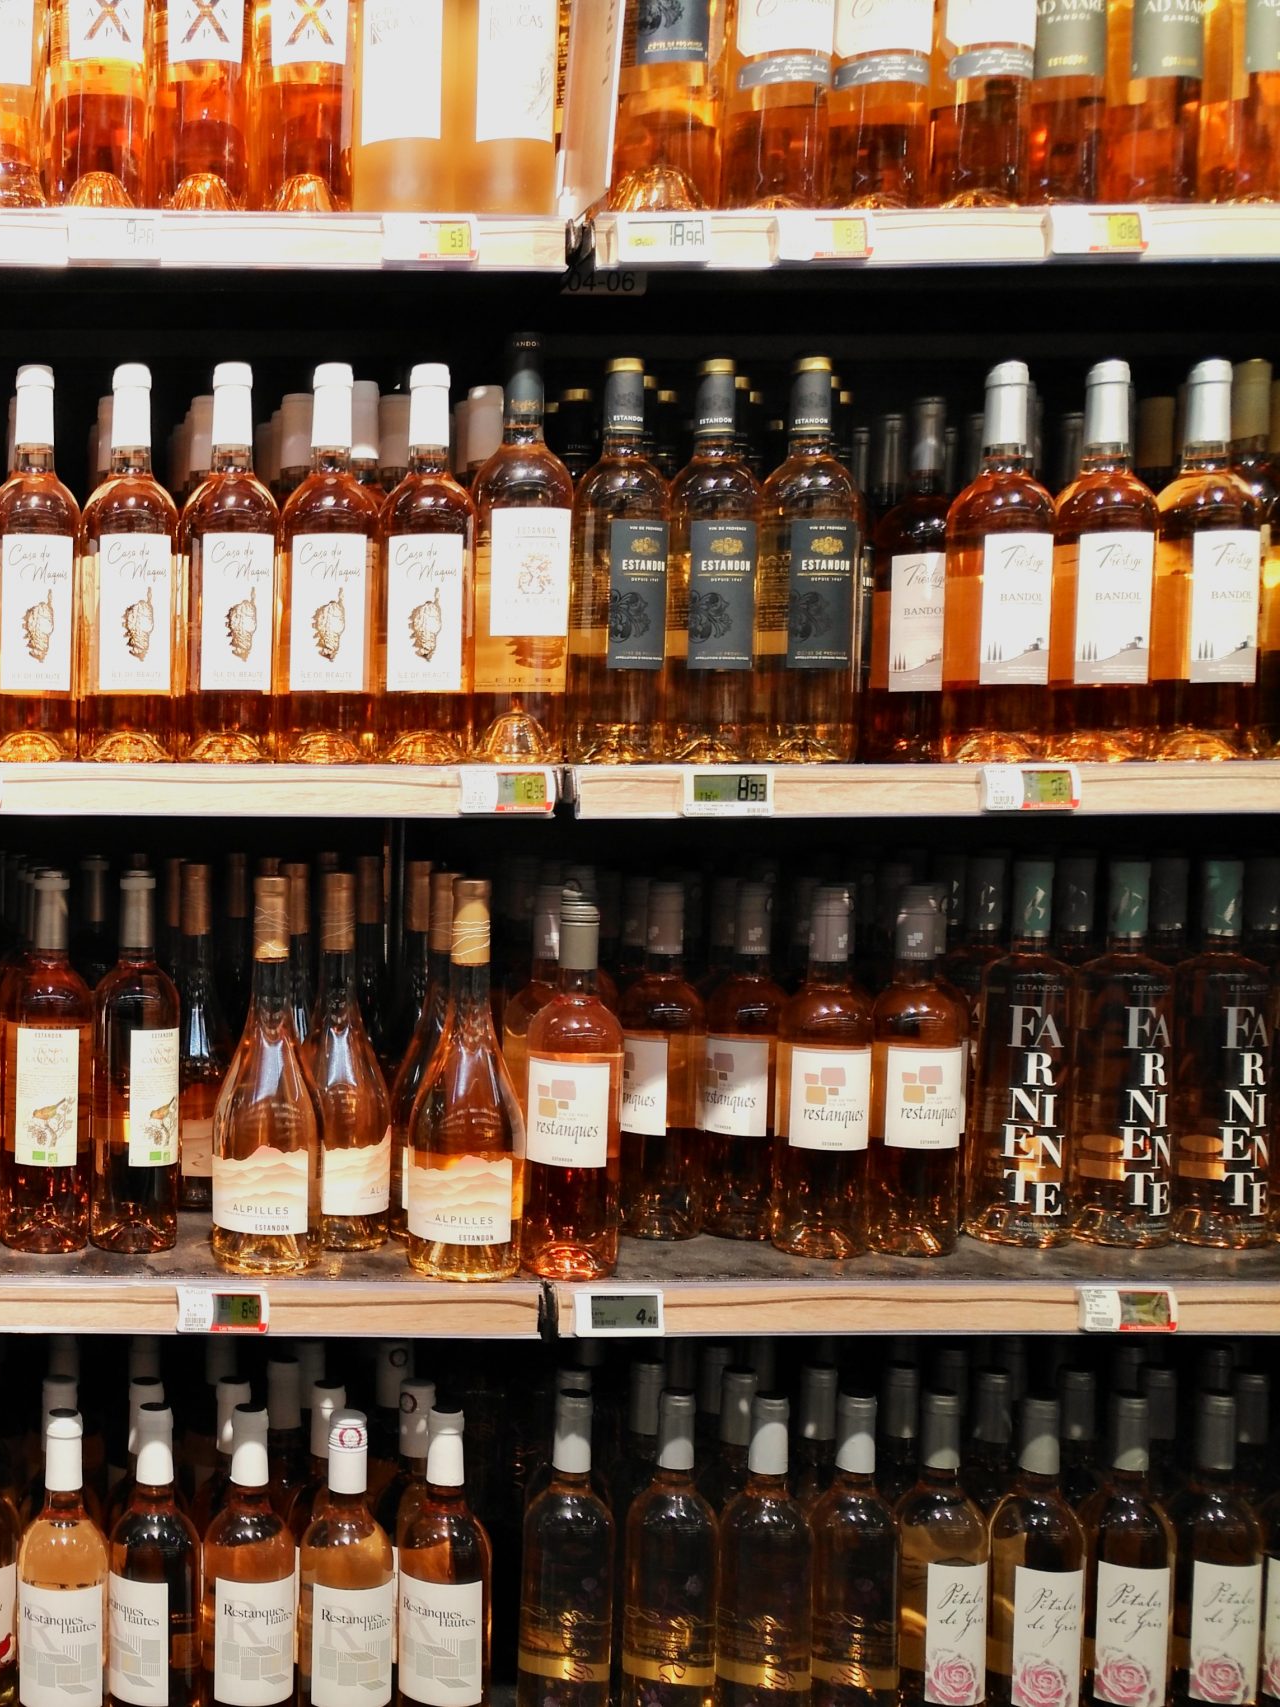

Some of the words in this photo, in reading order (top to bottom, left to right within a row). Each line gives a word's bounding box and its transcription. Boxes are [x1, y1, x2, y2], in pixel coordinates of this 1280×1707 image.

[568, 270, 636, 292] 04-06
[613, 415, 644, 423] ESTANDON
[699, 417, 733, 425] ESTANDON
[795, 417, 828, 425] ESTANDON
[9, 543, 37, 566] Casa
[40, 543, 51, 560] du
[108, 541, 135, 565] Casa
[139, 542, 150, 557] du
[210, 541, 241, 564] Casa
[243, 542, 255, 557] du
[299, 542, 329, 565] Casa
[331, 542, 342, 557] du
[395, 543, 424, 566] Casa
[427, 543, 438, 558] du
[20, 562, 68, 584] Maquis
[120, 561, 167, 583] Maquis
[223, 560, 270, 582] Maquis
[310, 559, 361, 583] Maquis
[406, 560, 458, 583] Maquis
[622, 559, 665, 572] ESTANDON
[701, 559, 751, 572] ESTANDON
[802, 559, 850, 572] ESTANDON
[1000, 592, 1043, 602] BANDOL
[1095, 591, 1143, 601] BANDOL
[1211, 591, 1253, 600] BANDOL
[803, 1106, 864, 1128] restanques
[901, 1105, 958, 1127] restanques
[536, 1119, 598, 1144] restanques
[233, 1203, 289, 1215] ALPILLES
[435, 1213, 494, 1225] ALPILLES
[255, 1224, 290, 1232] ESTANDON
[459, 1234, 494, 1242] ESTANDON
[223, 1603, 286, 1621] Restanques
[265, 1609, 293, 1625] Hautes
[403, 1596, 463, 1618] Restanques
[23, 1608, 84, 1630] Restanques
[61, 1619, 97, 1634] Hautes
[124, 1610, 159, 1626] Hautes
[321, 1610, 383, 1627] Restanques
[363, 1615, 391, 1632] Hautes
[439, 1611, 476, 1628] Hautes
[938, 1610, 958, 1625] de
[955, 1607, 983, 1642] Gris
[1108, 1610, 1127, 1625] de
[1124, 1608, 1162, 1642] Gris
[1204, 1610, 1224, 1625] de
[1221, 1607, 1255, 1642] Gris
[1026, 1615, 1045, 1630] de
[1042, 1613, 1077, 1647] Gris
